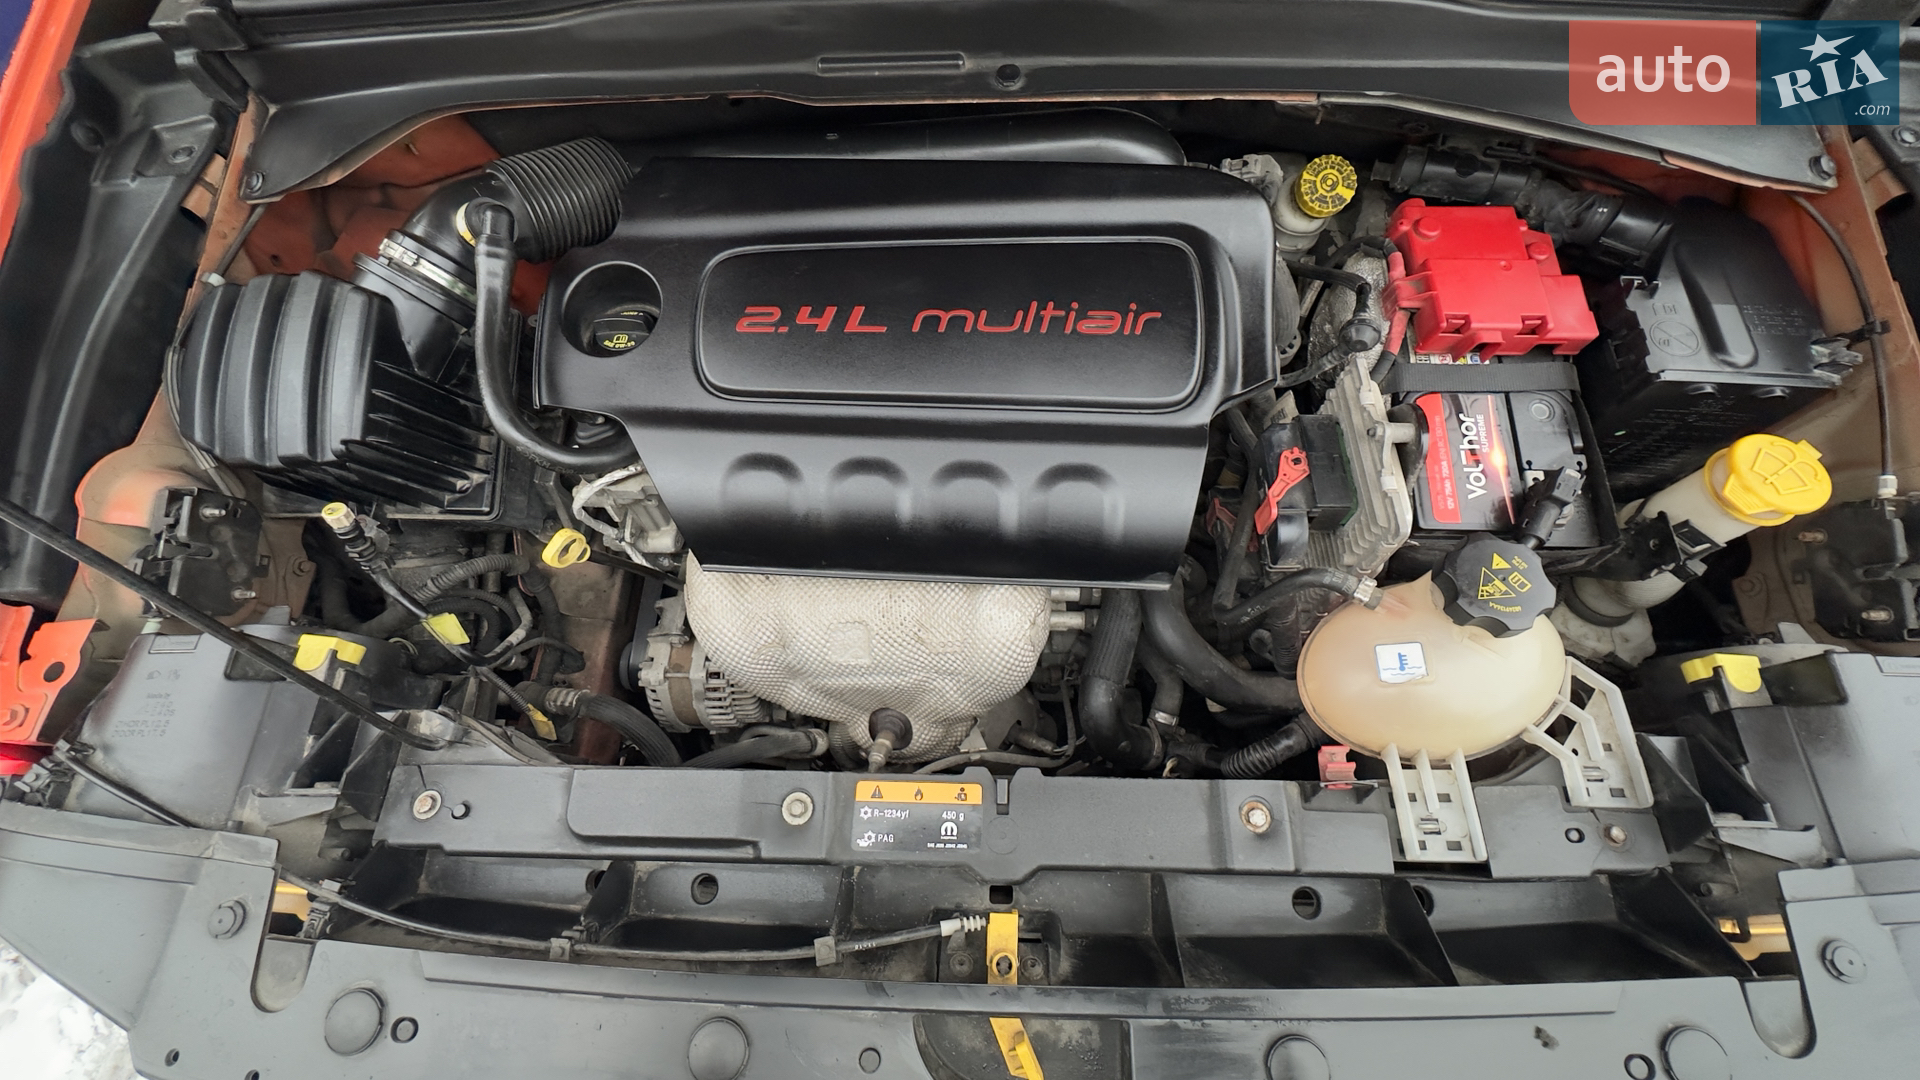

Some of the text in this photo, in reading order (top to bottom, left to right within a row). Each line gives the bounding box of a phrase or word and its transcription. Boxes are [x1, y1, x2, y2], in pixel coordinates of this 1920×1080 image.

[912, 301, 1162, 335] multiair
[1476, 414, 1490, 453] SUPREME
[1459, 413, 1488, 500] VolThor
[1446, 497, 1455, 510] 12V
[873, 808, 965, 821] R-1234yf 450 g
[877, 834, 894, 843] PAG
